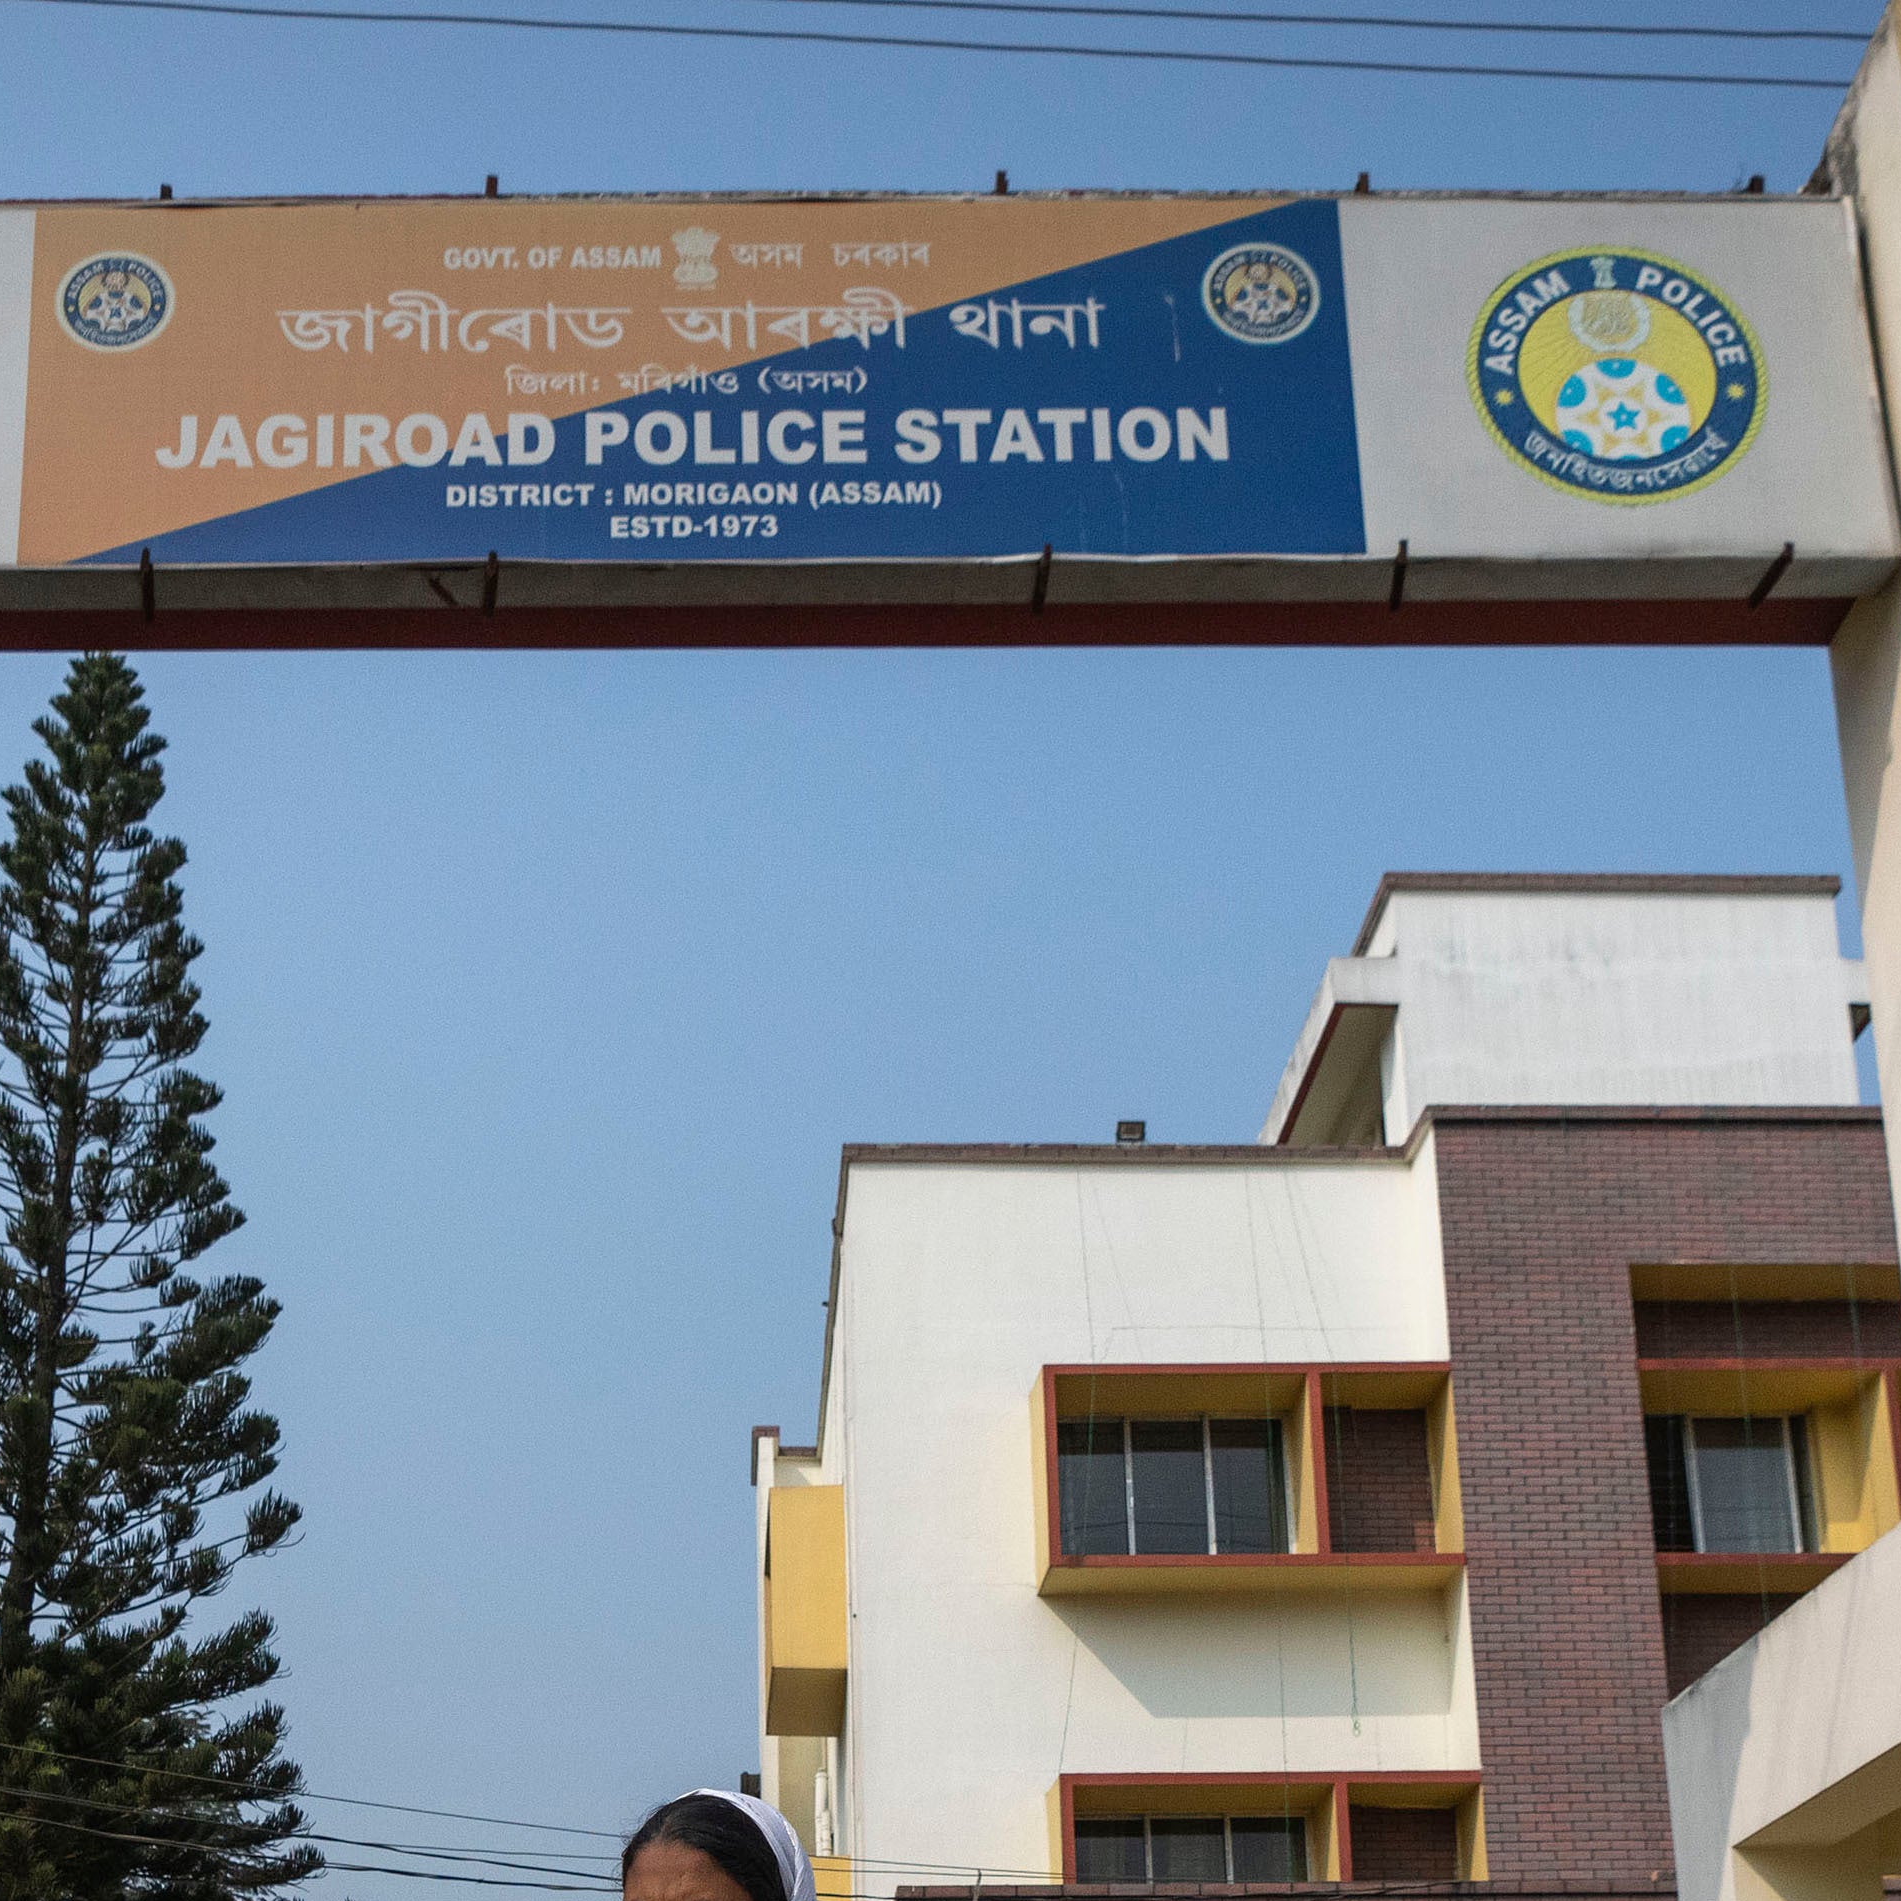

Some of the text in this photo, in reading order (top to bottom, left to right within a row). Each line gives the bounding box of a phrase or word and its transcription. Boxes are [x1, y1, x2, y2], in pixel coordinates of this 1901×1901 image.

[443, 246, 663, 271] GOVT. OF ASSAM
[949, 296, 1106, 350] থানা
[1484, 265, 1748, 376] ASSAM POLICE
[757, 365, 868, 395] (অসম)
[155, 406, 1230, 470] JAGIROAD POLICE STATION
[446, 483, 595, 508] DISTRICT
[623, 482, 799, 506] MORIGAON
[809, 481, 942, 509] (ASSAM)
[610, 515, 779, 539] ESTD-1973
